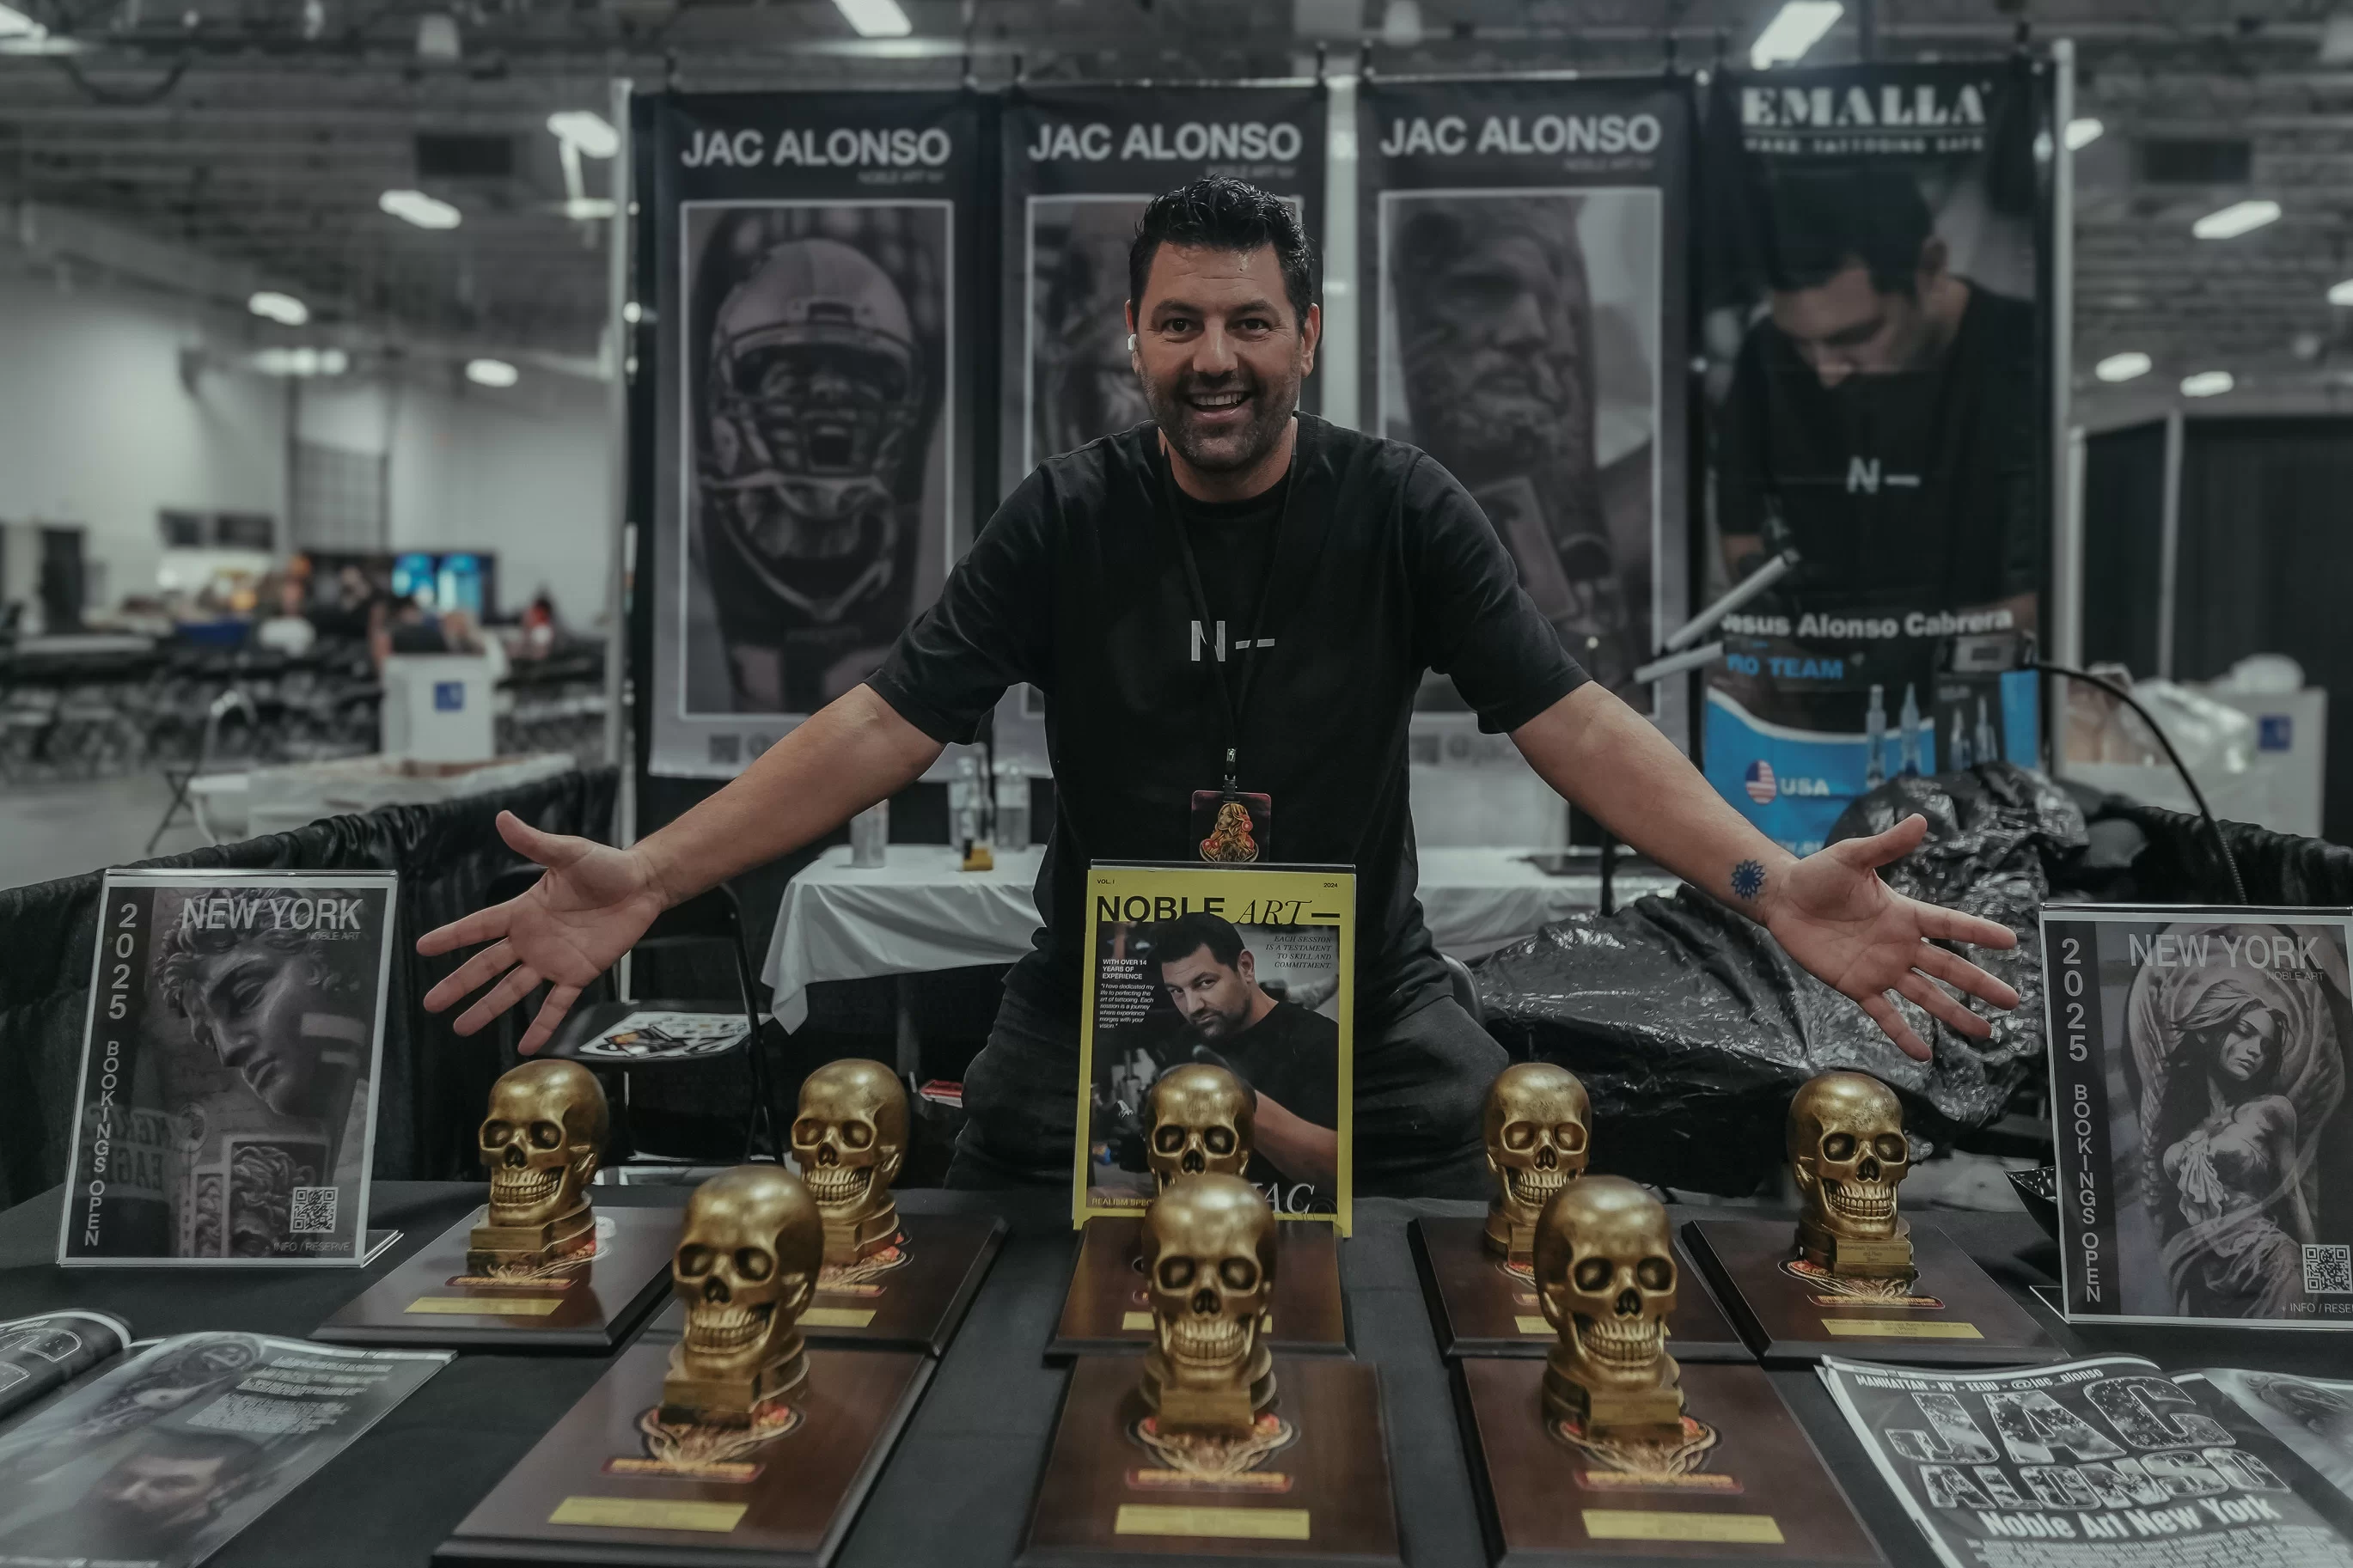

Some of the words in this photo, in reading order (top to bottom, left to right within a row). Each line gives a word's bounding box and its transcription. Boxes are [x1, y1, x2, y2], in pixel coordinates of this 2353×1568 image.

[1742, 84, 1986, 126] EMALLA
[681, 129, 764, 167] JAC
[773, 129, 951, 167] ALONSO
[1028, 122, 1112, 162] JAC
[1121, 121, 1303, 162] ALONSO
[1380, 117, 1466, 156] JAC
[1480, 114, 1662, 155] ALONSO
[1797, 612, 1898, 639] Alonso
[1904, 609, 2014, 638] Cabrera
[1767, 656, 1844, 679] TEAM
[1780, 778, 1830, 796] USA
[181, 898, 260, 930] NEW
[268, 898, 364, 930] YORK
[307, 931, 339, 941] NOBLE
[341, 931, 361, 941] ART
[2129, 933, 2210, 967] NEW
[2218, 935, 2324, 970] YORK
[108, 903, 138, 1020] 2025
[2266, 971, 2301, 981] NOBLE
[2304, 972, 2325, 982] ART
[2061, 937, 2088, 1062] 2025
[93, 1040, 119, 1174] BOOKINGS
[2074, 1083, 2096, 1225] BOOKINGS
[84, 1180, 106, 1247] OPEN
[1092, 1197, 1128, 1206] REALISM
[1130, 1198, 1155, 1207] SPEC
[1250, 1181, 1315, 1215] AC
[273, 1242, 297, 1252] INFO
[305, 1241, 351, 1252] RESERVE
[2081, 1231, 2101, 1303] OPEN
[2289, 1303, 2316, 1314] INFO
[2325, 1303, 2353, 1314] RESE
[1855, 1375, 1929, 1391] MANHATTAN
[1936, 1382, 1956, 1392] NY
[1965, 1382, 2000, 1392] EEUU
[1885, 1376, 2236, 1464] JAC
[1919, 1447, 2291, 1510] ALONSO
[1978, 1510, 2077, 1539] Noble
[2076, 1510, 2130, 1539] Art
[2124, 1504, 2203, 1538] New
[2197, 1493, 2283, 1526] York
